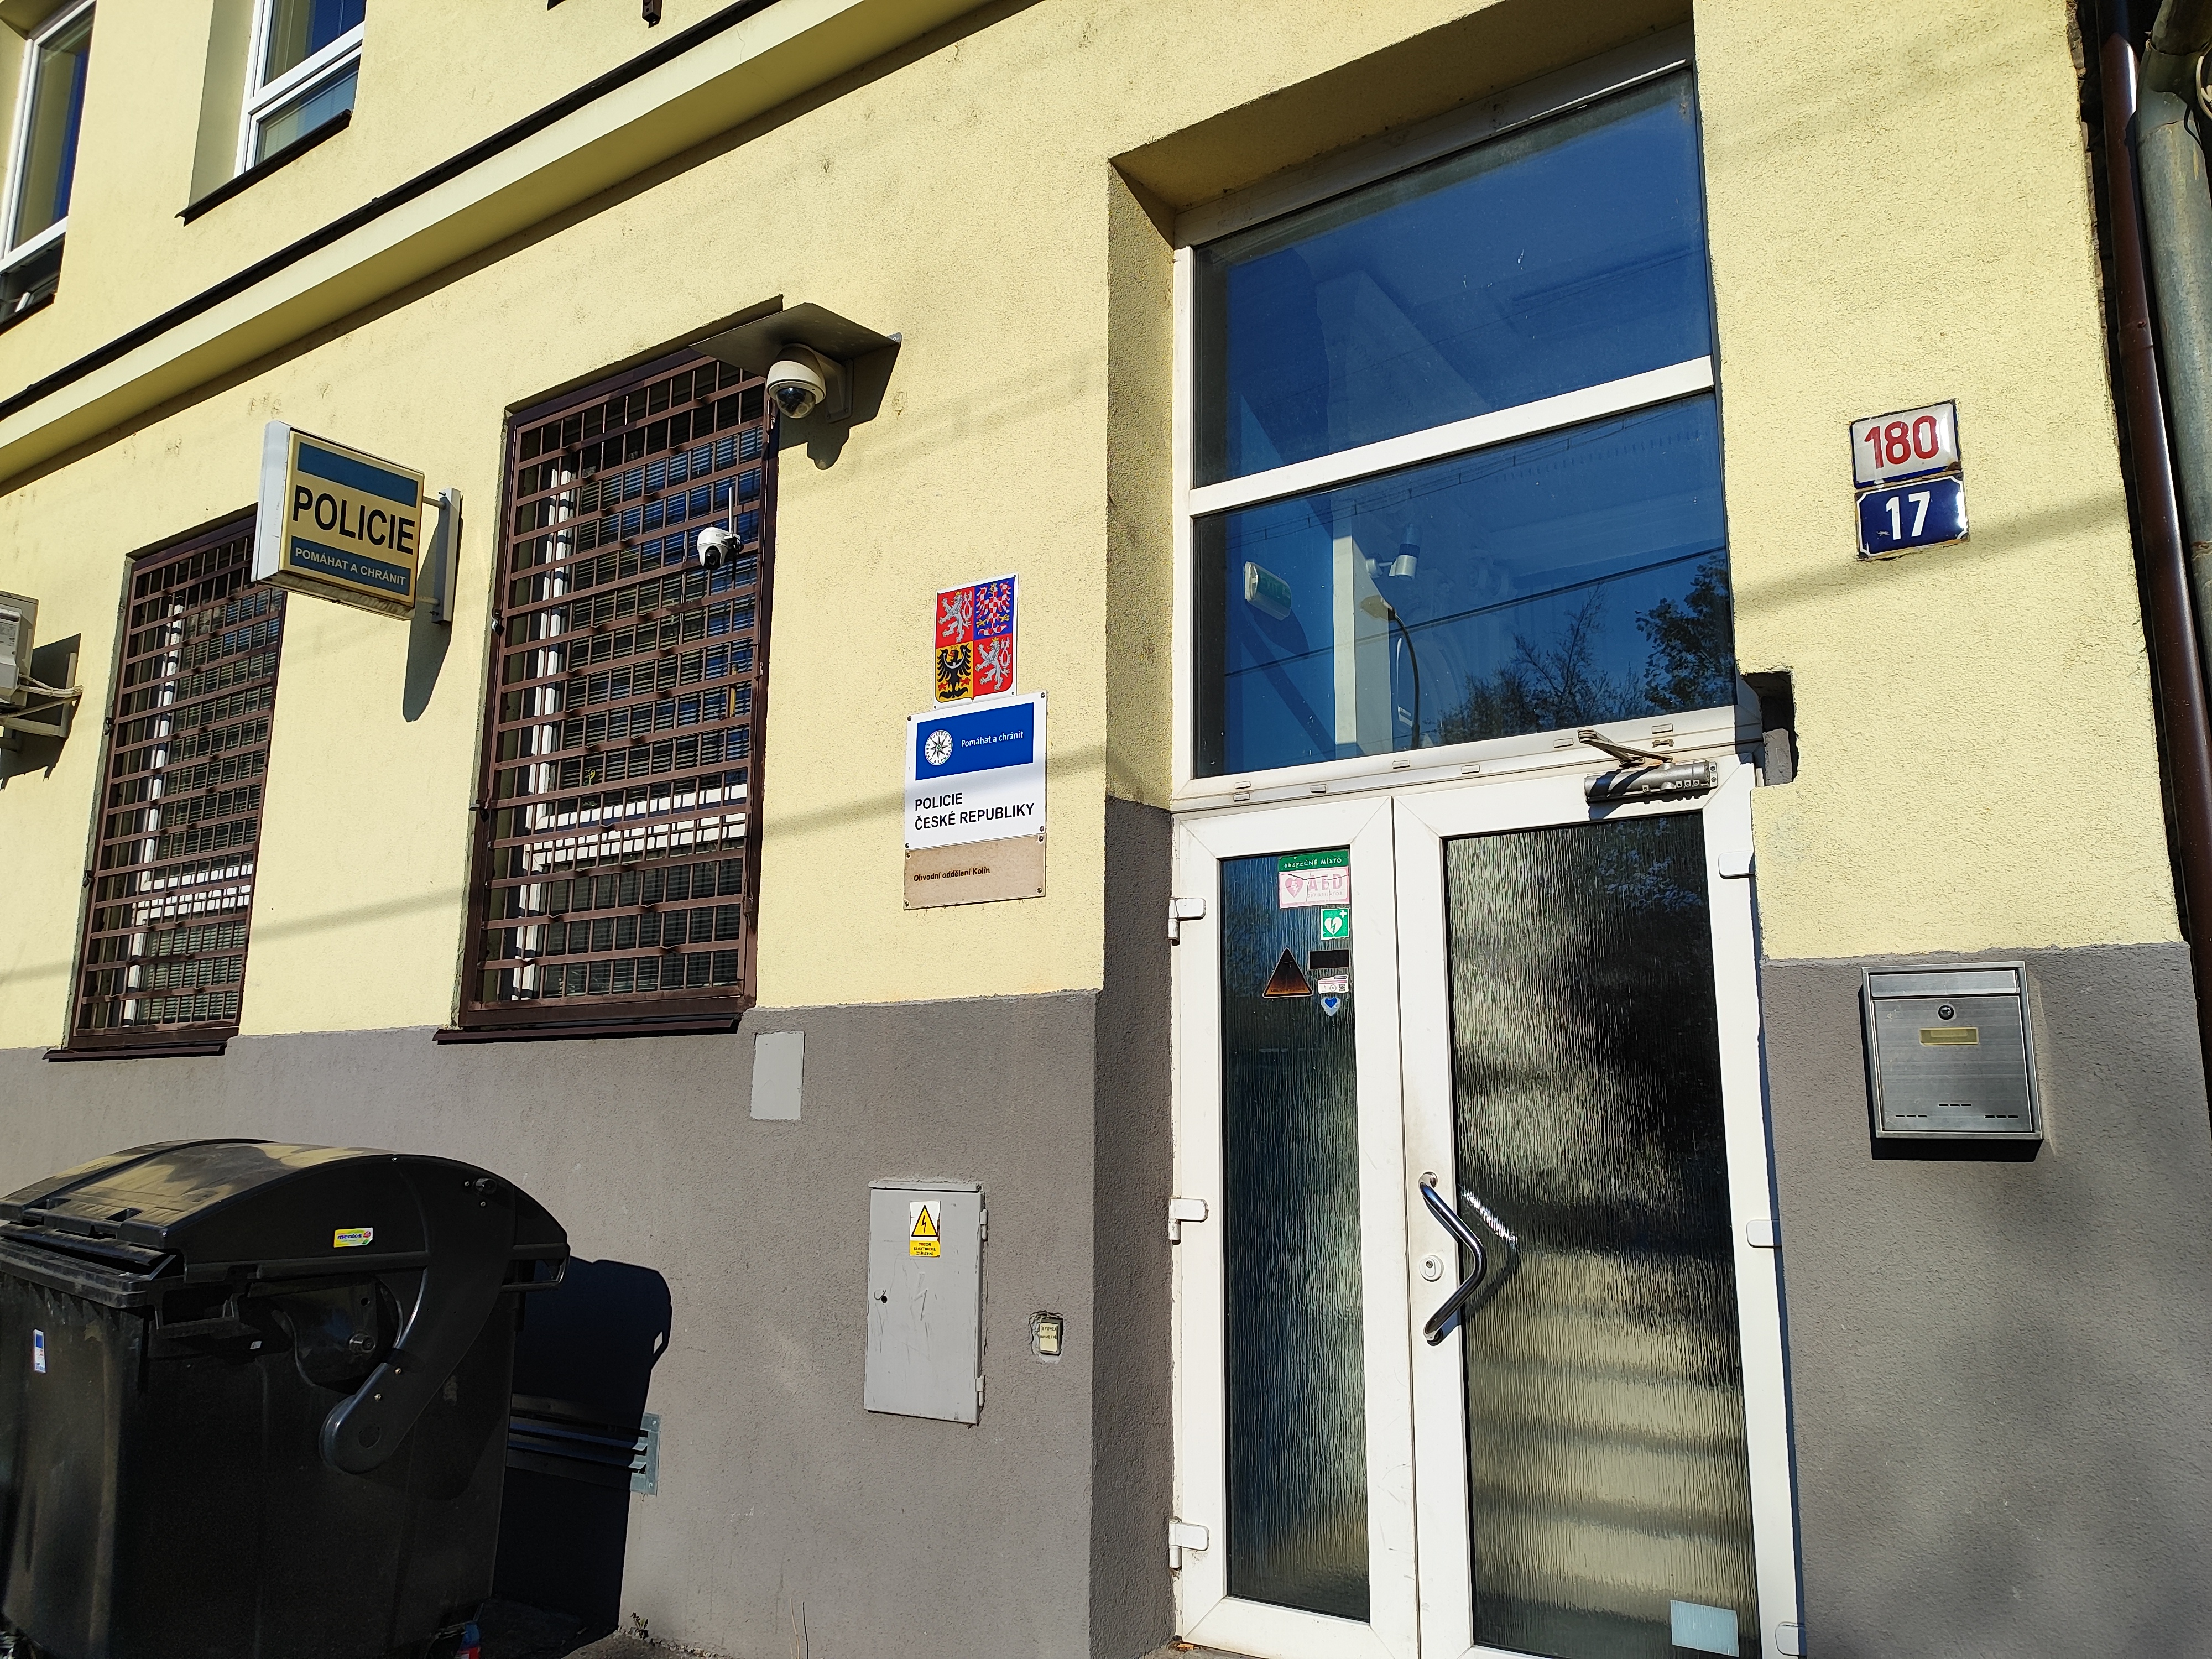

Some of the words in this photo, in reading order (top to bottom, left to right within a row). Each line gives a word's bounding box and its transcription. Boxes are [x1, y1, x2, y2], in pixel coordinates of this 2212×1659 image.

[1864, 415, 1939, 469] 180
[293, 484, 415, 555] POLICIE
[1886, 491, 1931, 540] 17
[295, 547, 348, 570] POMÁHAT
[350, 564, 358, 573] A
[360, 565, 406, 586] CHRÁNIT
[961, 735, 992, 748] Pomáhat
[999, 730, 1024, 742] chránit
[915, 792, 963, 811] POLICIE
[915, 811, 956, 830] ČESKÉ
[959, 802, 1035, 824] REPUBLIKY
[914, 872, 941, 881] Obvodní
[942, 868, 971, 879] oddělení
[972, 866, 990, 876] Kolín
[1284, 858, 1318, 868] BEZPEČNÉ
[1308, 873, 1343, 891] AED
